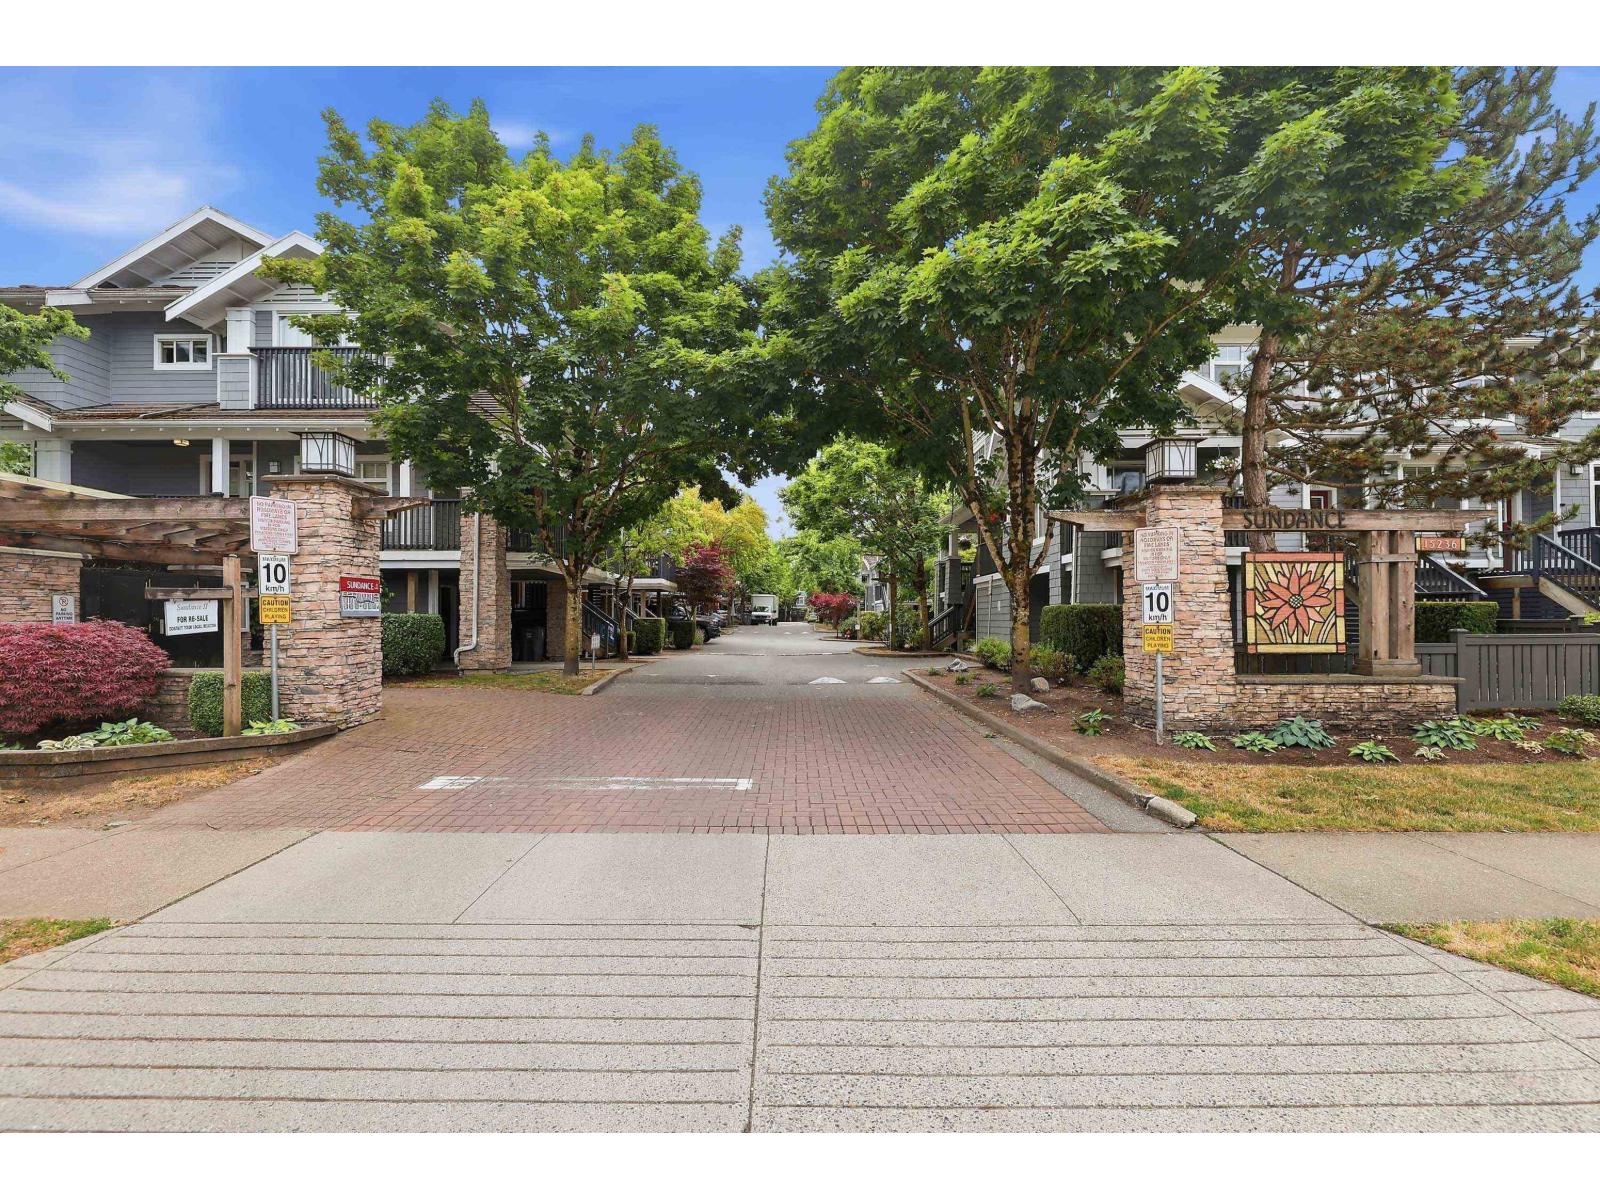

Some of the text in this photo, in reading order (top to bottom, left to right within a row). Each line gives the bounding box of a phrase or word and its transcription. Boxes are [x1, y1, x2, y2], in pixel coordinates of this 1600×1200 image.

[1243, 510, 1346, 529] SUNDANCE
[1423, 540, 1457, 549] 15236
[262, 562, 287, 584] 10
[346, 580, 374, 590] SUNDANCE
[1145, 591, 1169, 613] 10
[188, 614, 209, 622] RE-SALE
[1148, 613, 1168, 621] km/h
